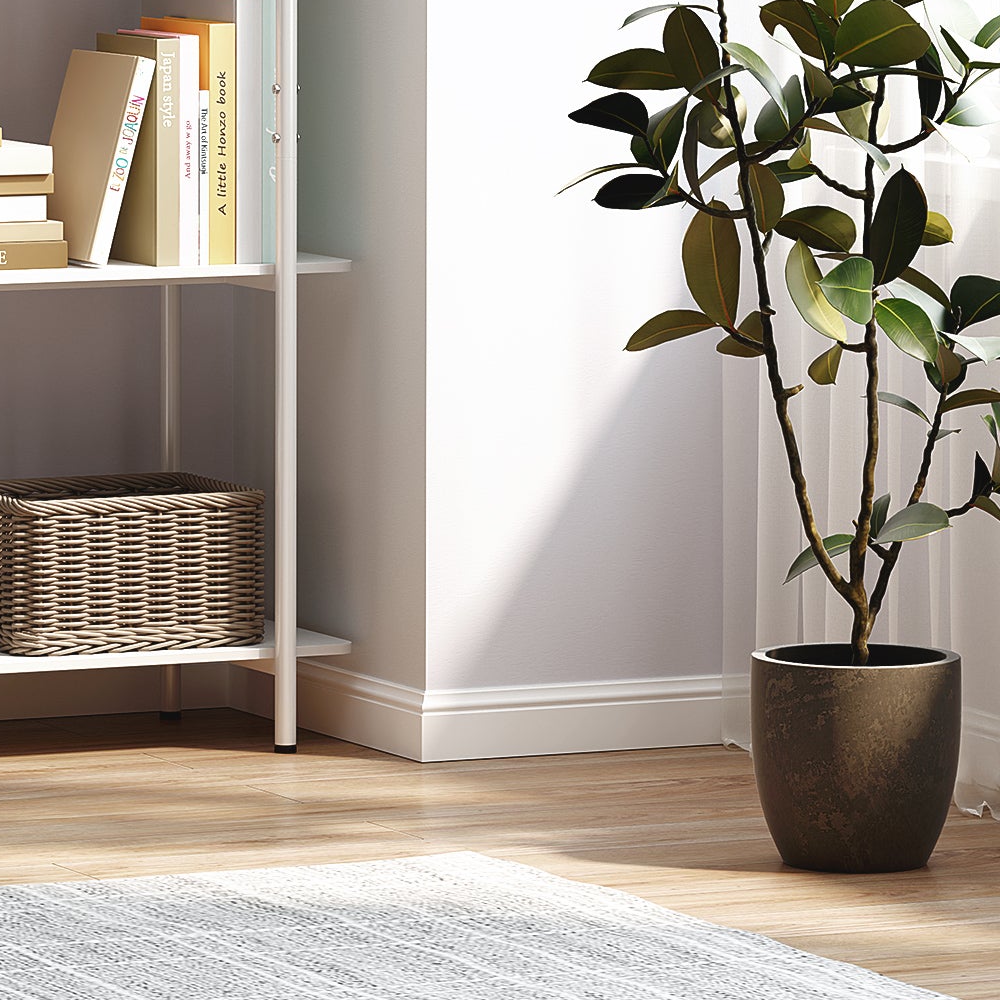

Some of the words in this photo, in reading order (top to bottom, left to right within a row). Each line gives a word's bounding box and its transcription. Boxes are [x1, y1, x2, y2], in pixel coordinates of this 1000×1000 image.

[159, 52, 176, 93] Japan
[217, 71, 228, 105] book
[160, 95, 176, 128] style
[185, 120, 192, 131] go
[201, 109, 209, 122] The
[217, 111, 227, 157] Honzo
[185, 141, 193, 161] away
[199, 144, 208, 175] Kintsugi
[217, 163, 228, 198] little
[218, 203, 227, 215] A
